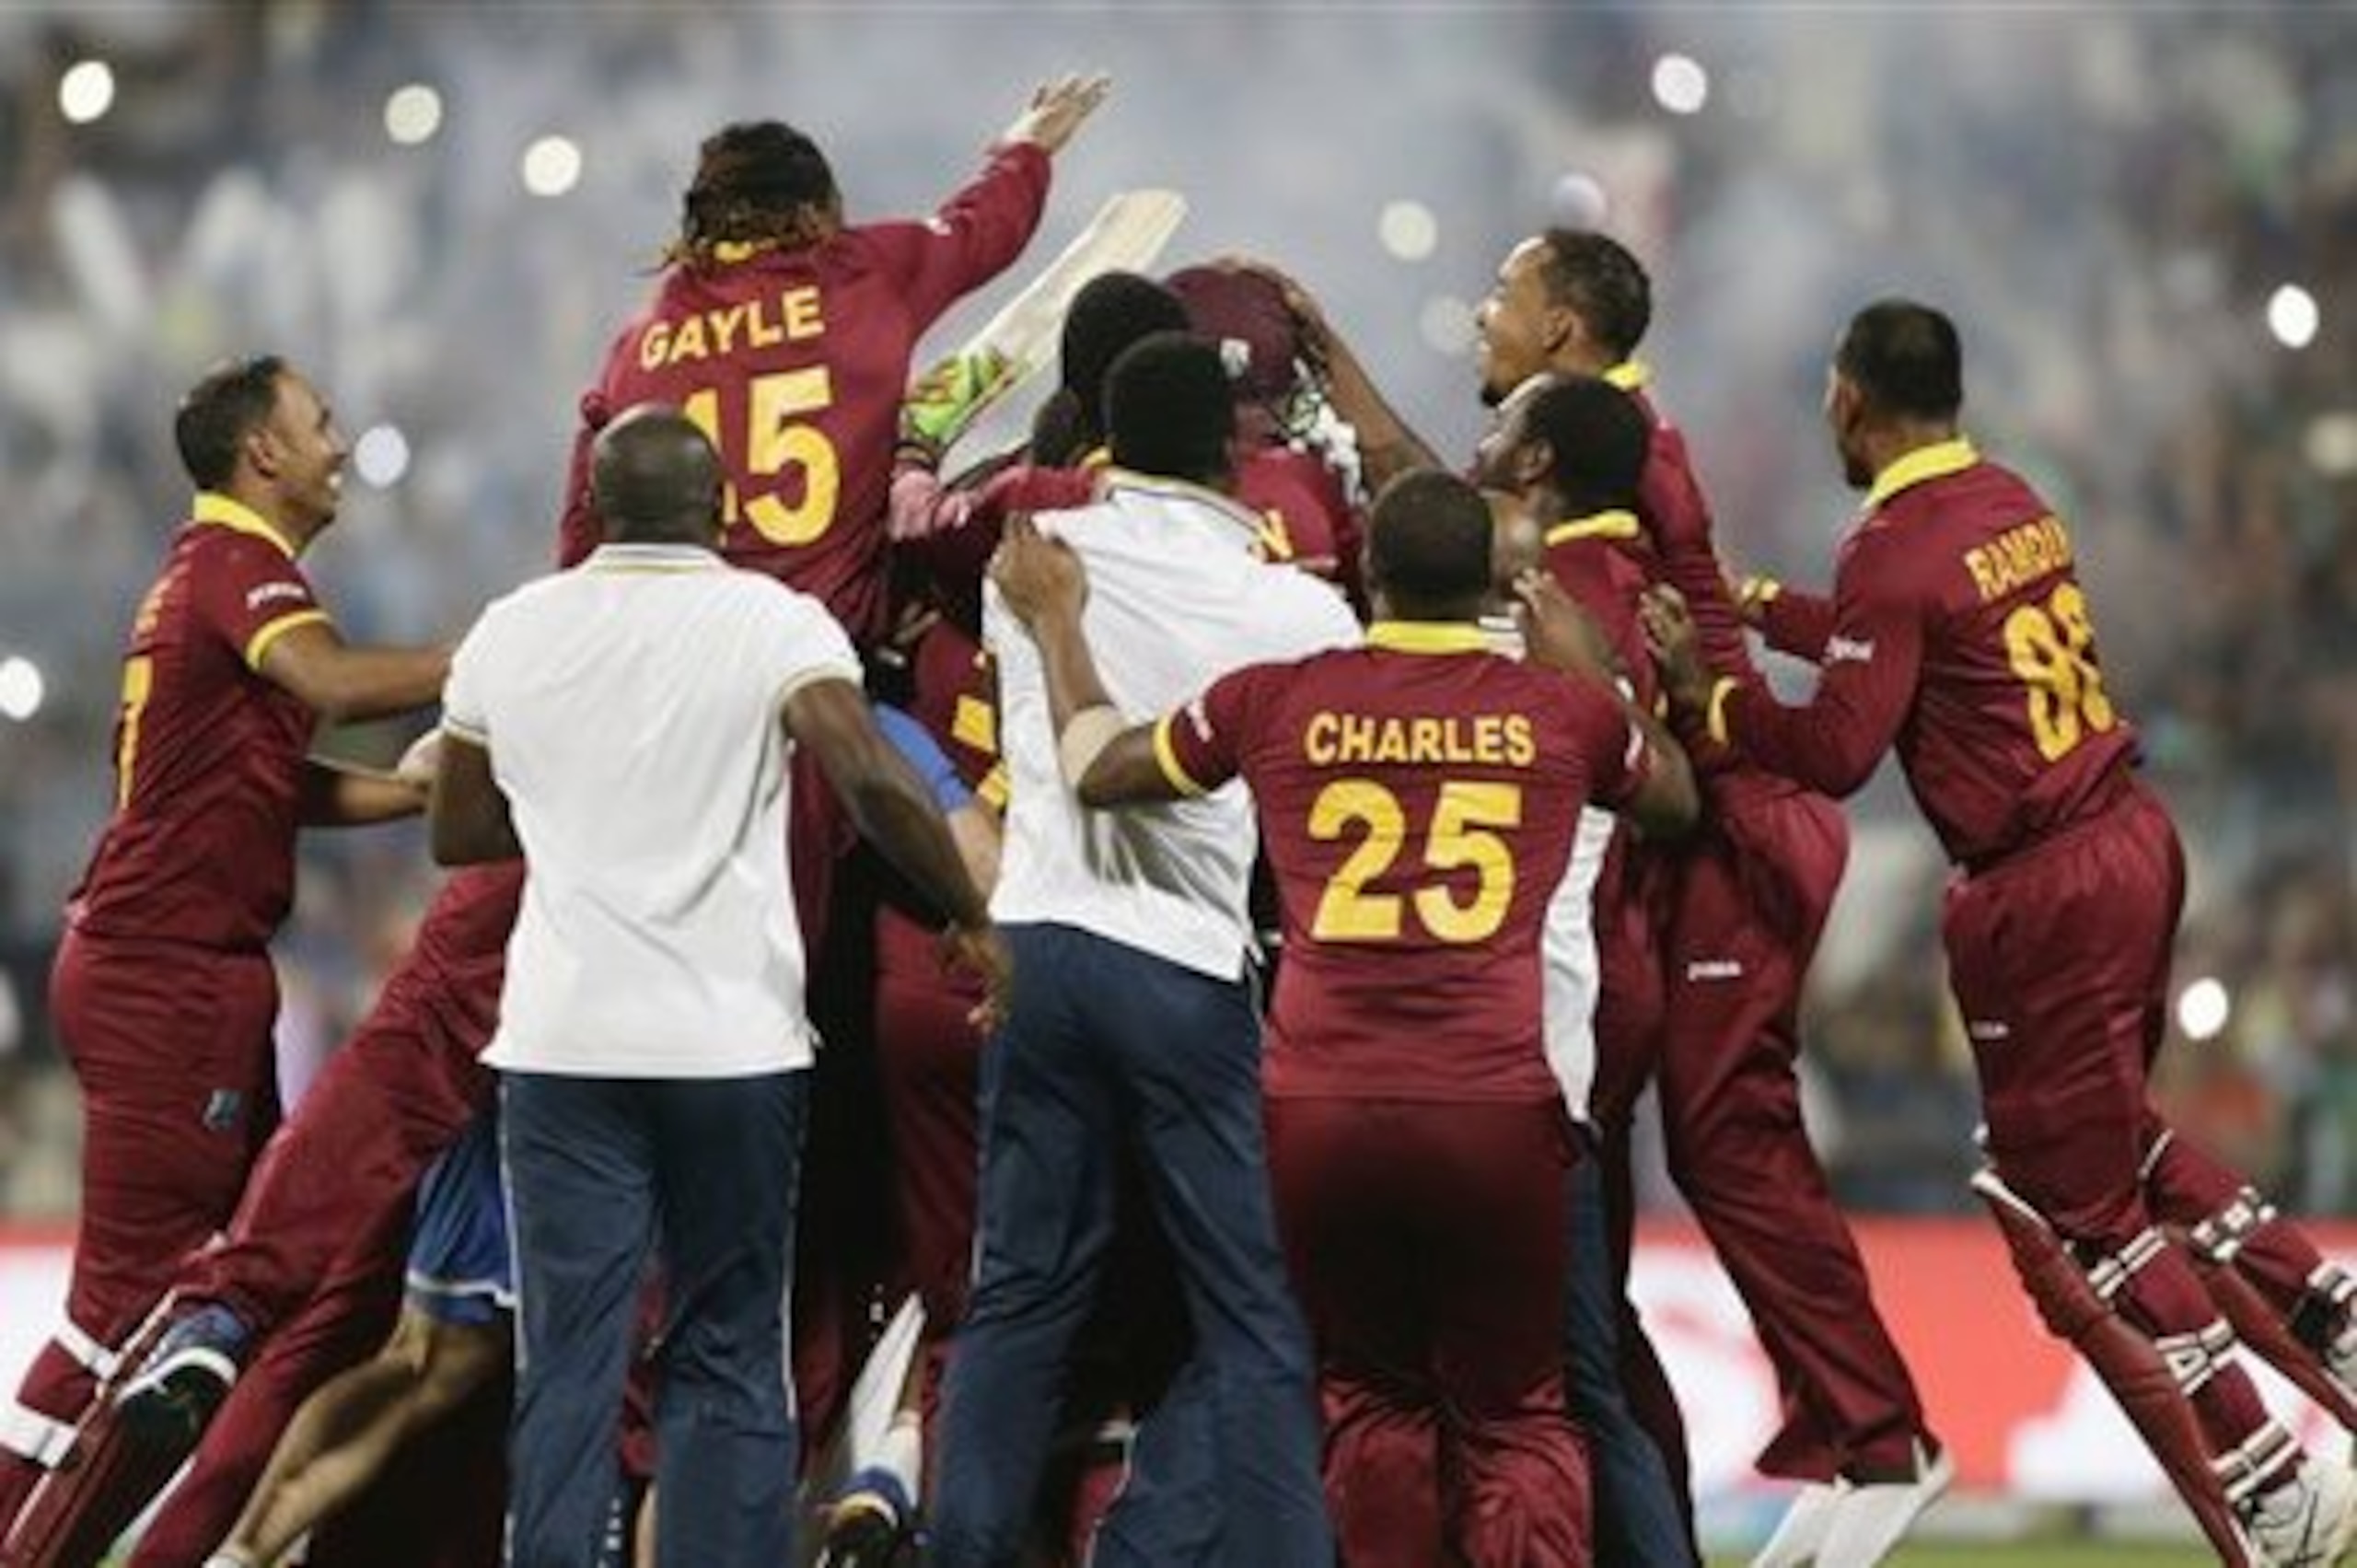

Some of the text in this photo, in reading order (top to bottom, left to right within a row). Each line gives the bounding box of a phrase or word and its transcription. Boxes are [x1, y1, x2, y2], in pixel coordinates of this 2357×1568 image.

[640, 286, 824, 370] GAYLE
[1306, 713, 1534, 765] CHARLES
[1307, 778, 1521, 942] 25
